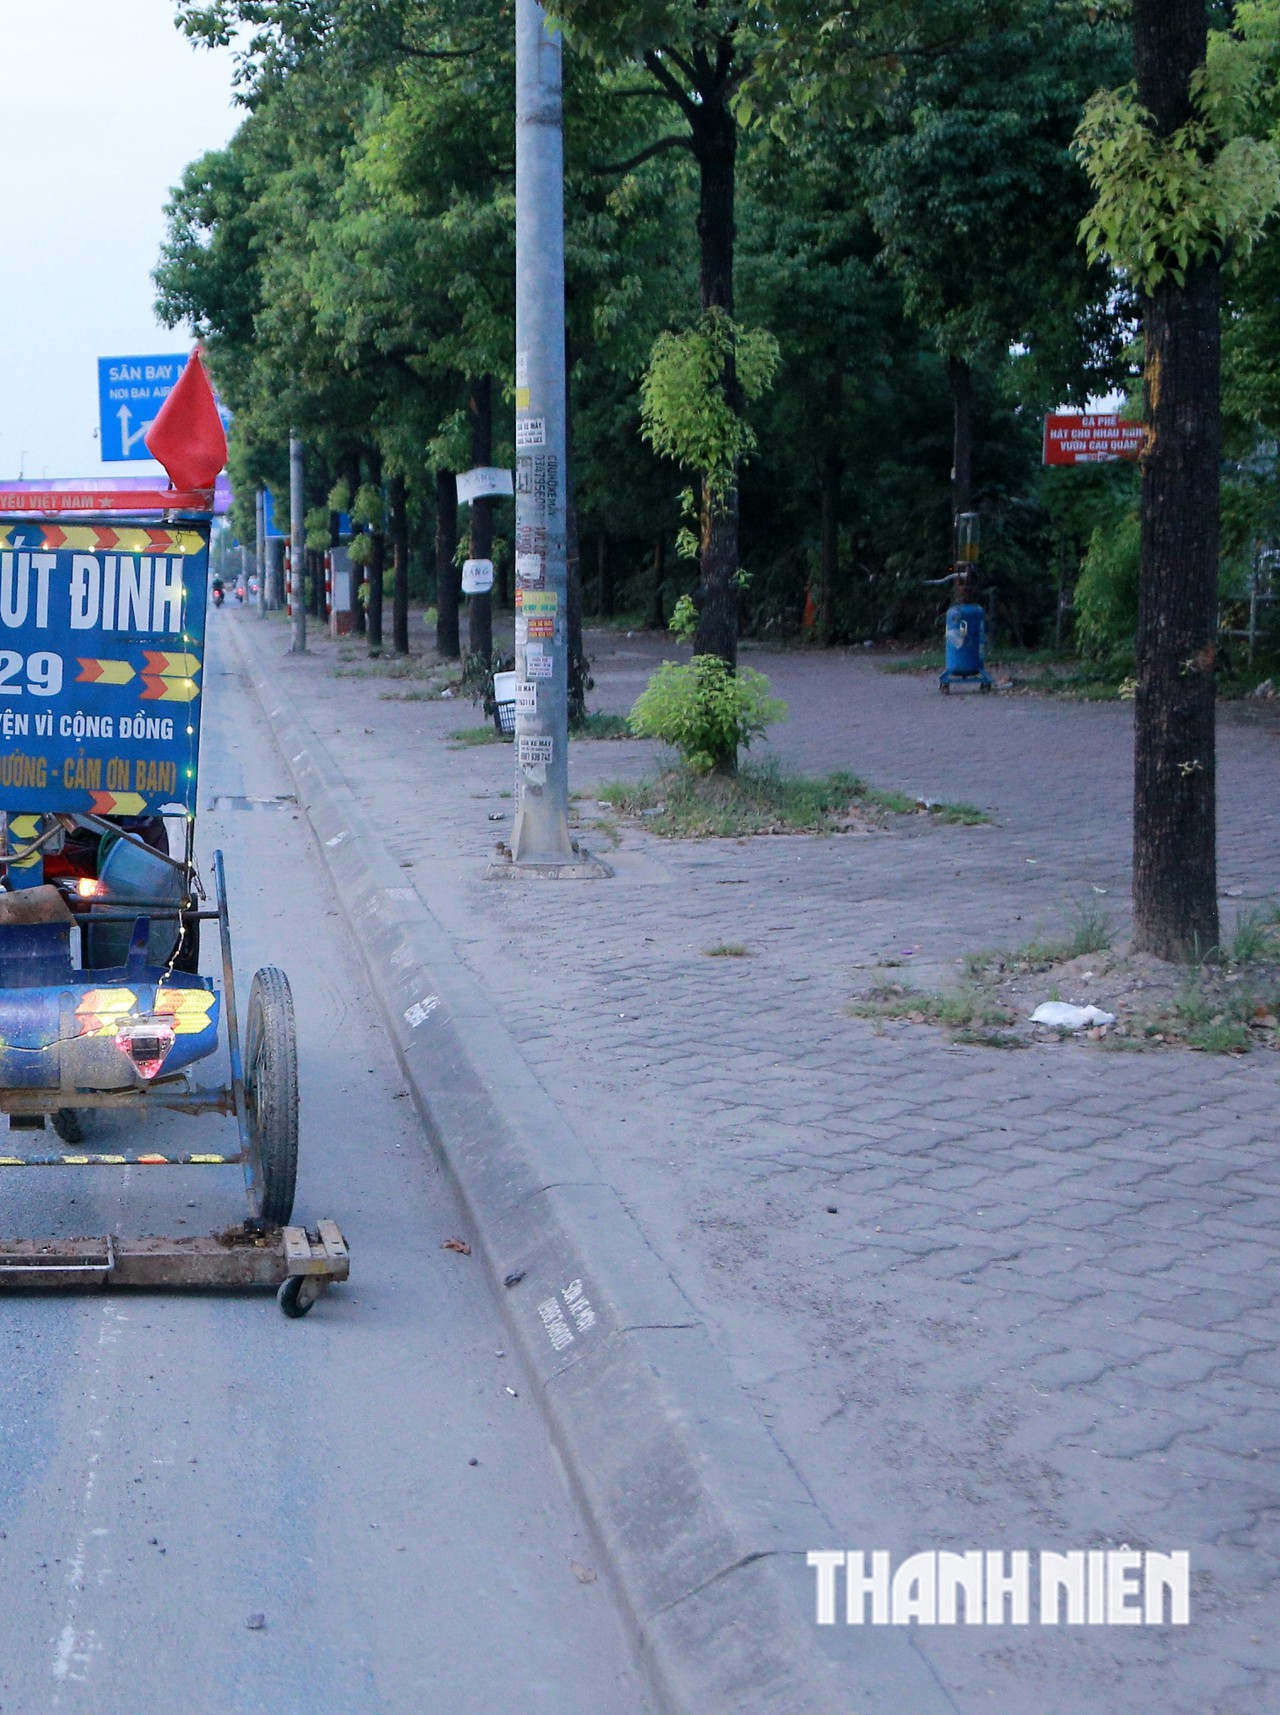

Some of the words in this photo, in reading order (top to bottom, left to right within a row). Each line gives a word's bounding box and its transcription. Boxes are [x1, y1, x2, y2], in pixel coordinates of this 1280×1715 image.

[109, 364, 141, 381] SÂN
[145, 366, 172, 380] BAY
[1071, 429, 1091, 439] CHO
[1093, 428, 1119, 439] NHAU
[0, 492, 25, 508] YÊU
[61, 495, 94, 508] NAM
[70, 554, 183, 633] ĐINH
[35, 709, 53, 736] VÌ
[59, 709, 113, 741] CỘNG
[119, 709, 174, 740] ĐỒNG
[63, 747, 102, 790] CẢM
[107, 757, 131, 790] ƠN
[135, 760, 177, 796] BẠN)
